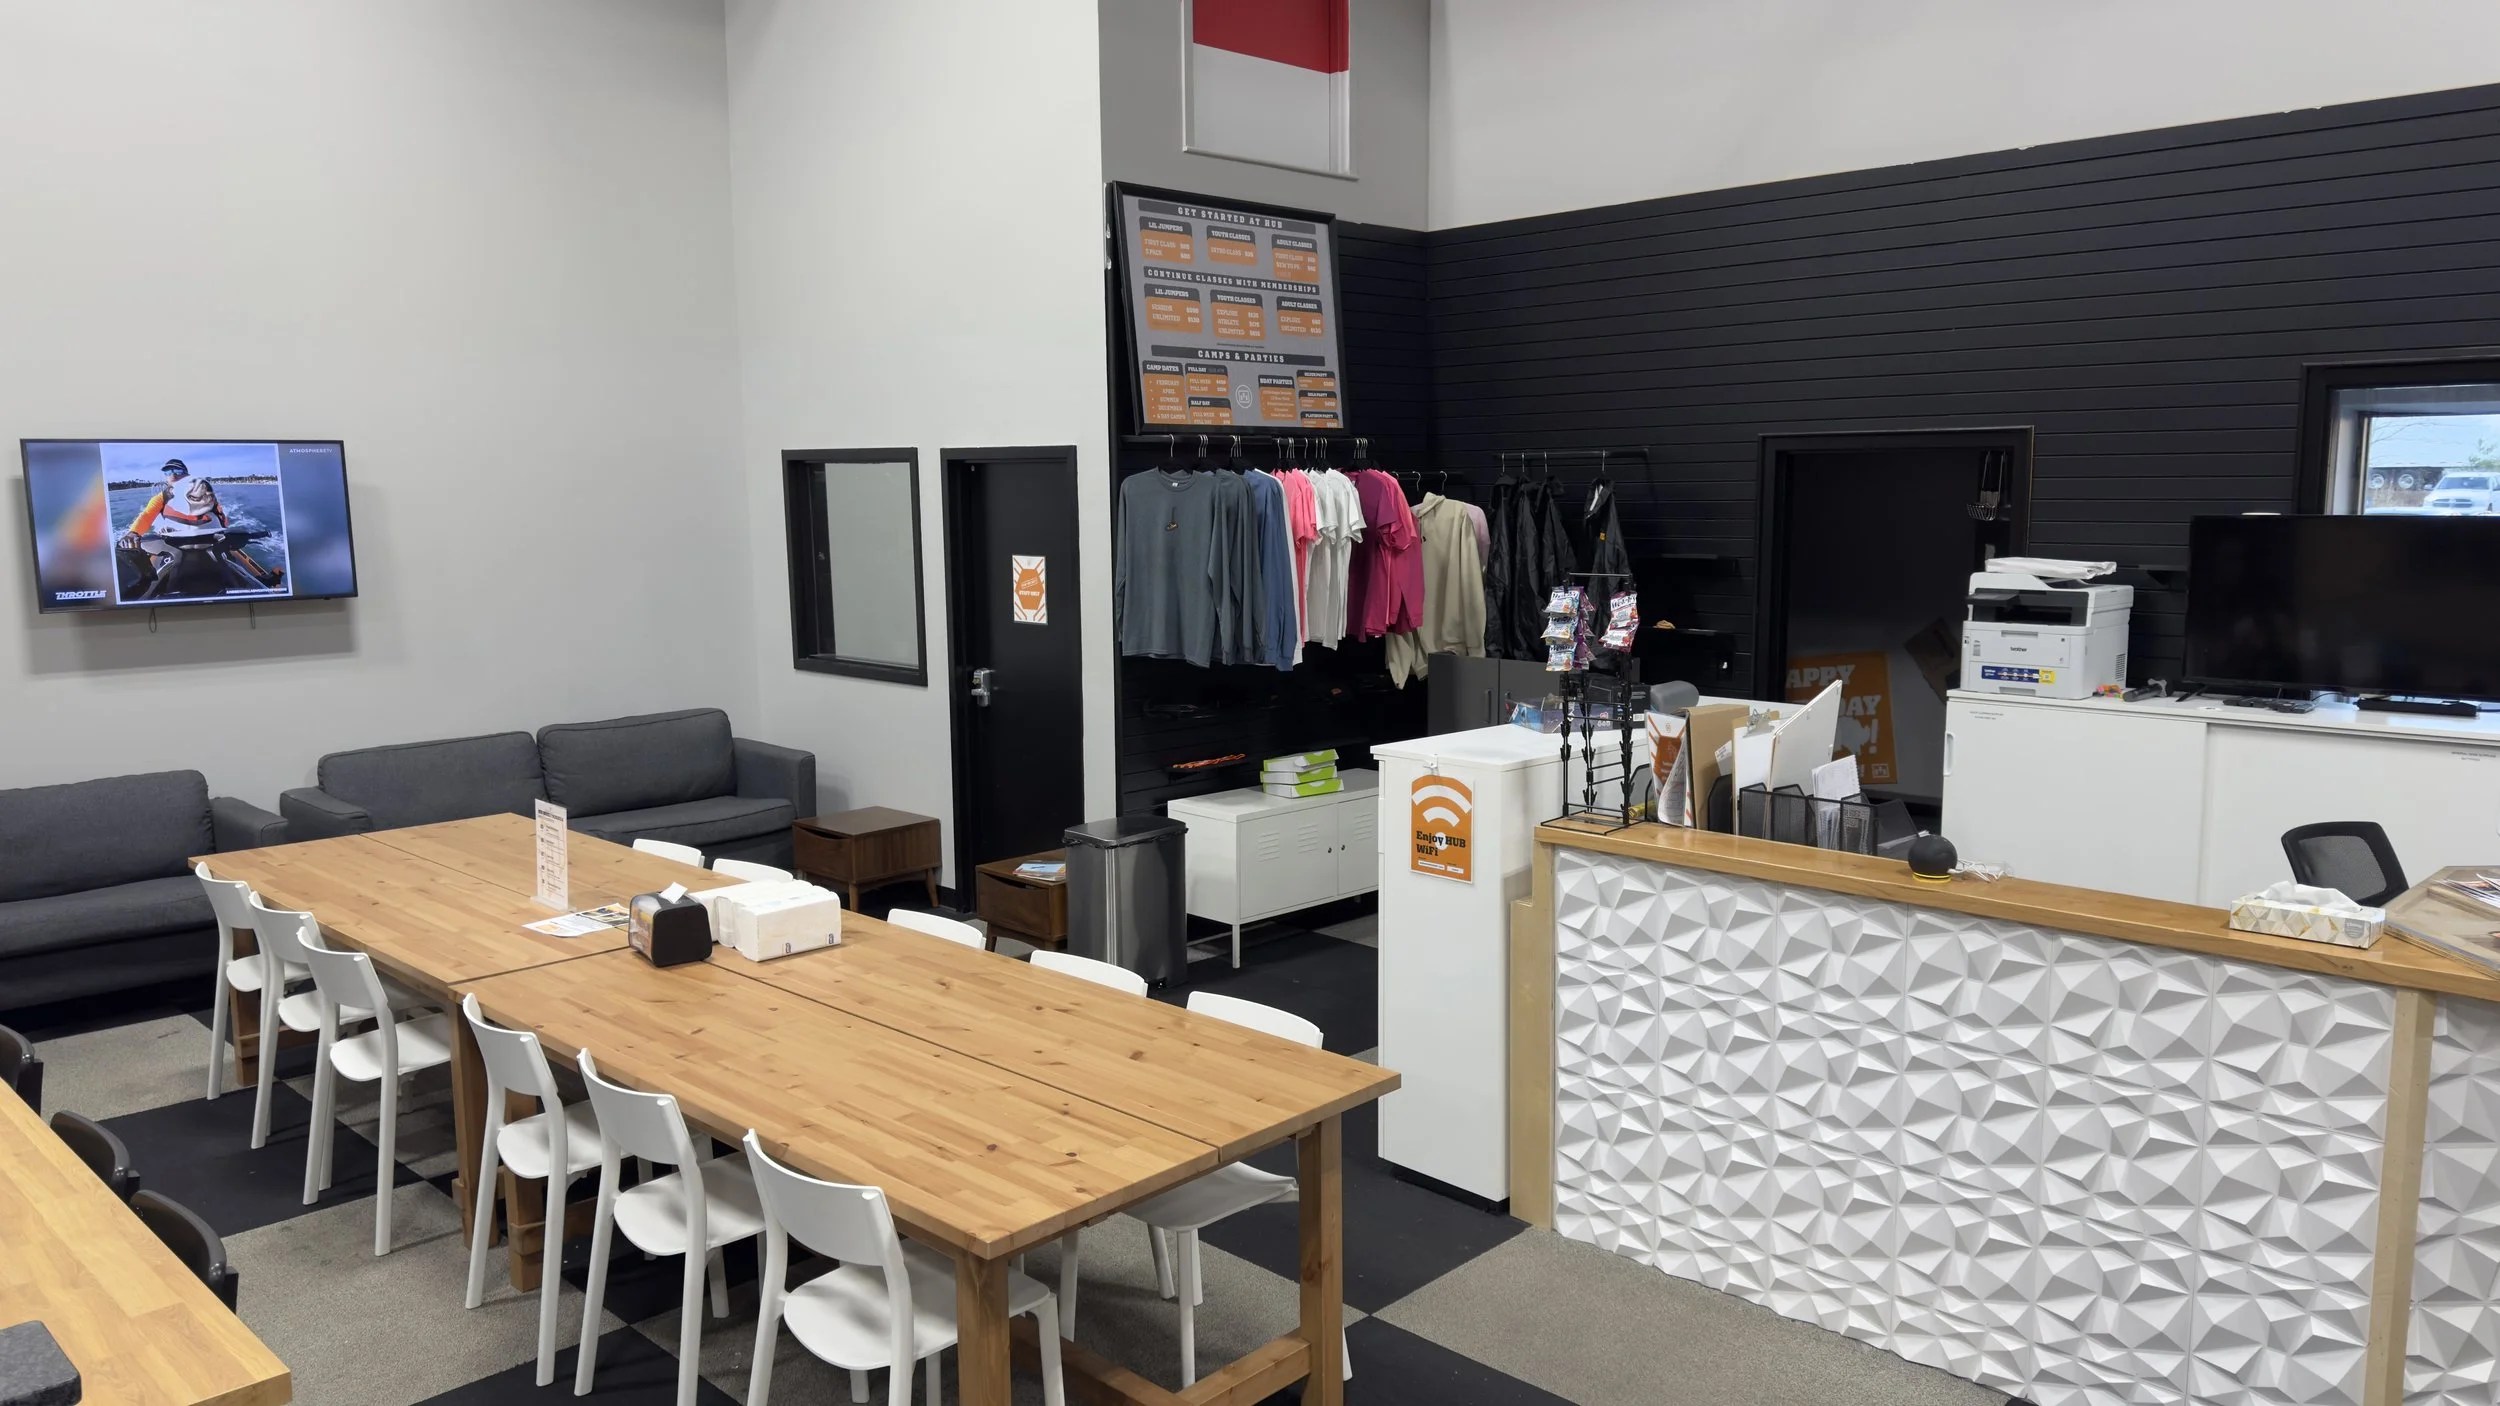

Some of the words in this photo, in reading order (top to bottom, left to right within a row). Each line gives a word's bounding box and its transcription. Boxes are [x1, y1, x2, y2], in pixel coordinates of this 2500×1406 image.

[1177, 206, 1197, 217] GET
[1201, 210, 1245, 223] STARTED
[1249, 217, 1261, 226] AT
[1264, 219, 1283, 228] HUB
[1158, 223, 1184, 232] JUMPERS
[1211, 230, 1229, 238] YOUTH
[1229, 232, 1251, 241] CLASSES
[1160, 240, 1176, 249] CLASS
[1276, 239, 1292, 247] ADULT
[1292, 240, 1313, 249] CLASSES
[1147, 269, 1192, 280] CONTINUE
[1196, 273, 1233, 284] CLASSES
[1236, 278, 1258, 287] WITH
[1260, 281, 1317, 293] MEMBERSHIPS
[1164, 289, 1189, 297] JUMPERS
[1216, 294, 1235, 302] YOUTH
[1235, 296, 1256, 304] CLASSES
[1281, 300, 1297, 308] ADULT
[1297, 301, 1318, 309] CLASSES
[1197, 350, 1230, 360] CAMPS
[1234, 352, 1240, 360] &
[1244, 353, 1285, 363] PARTIES
[55, 590, 107, 600] THROTTLE
[1786, 664, 1856, 688] APPY
[1416, 830, 1444, 847] Enjoy
[1445, 836, 1466, 848] HUB
[1416, 843, 1438, 857] WiFi
